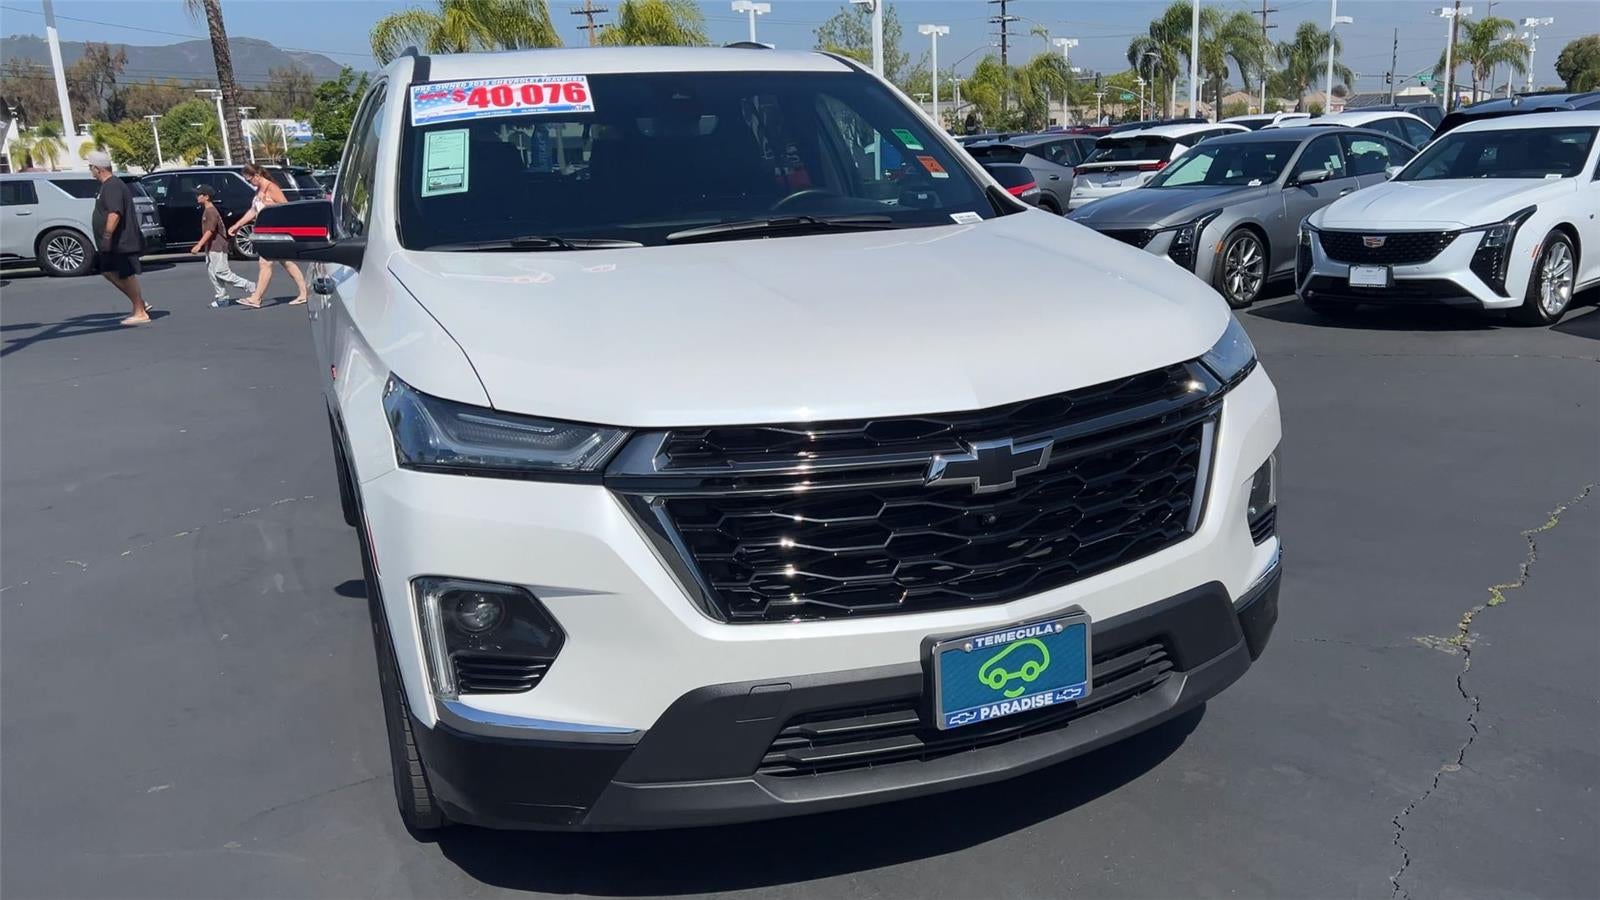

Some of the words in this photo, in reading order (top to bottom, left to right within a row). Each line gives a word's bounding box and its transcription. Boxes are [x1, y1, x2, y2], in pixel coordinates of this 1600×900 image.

[493, 77, 539, 86] CHEVROLET
[452, 82, 587, 108] $40,076
[976, 624, 1053, 647] TEMECULA
[980, 693, 1053, 719] PARADISE
